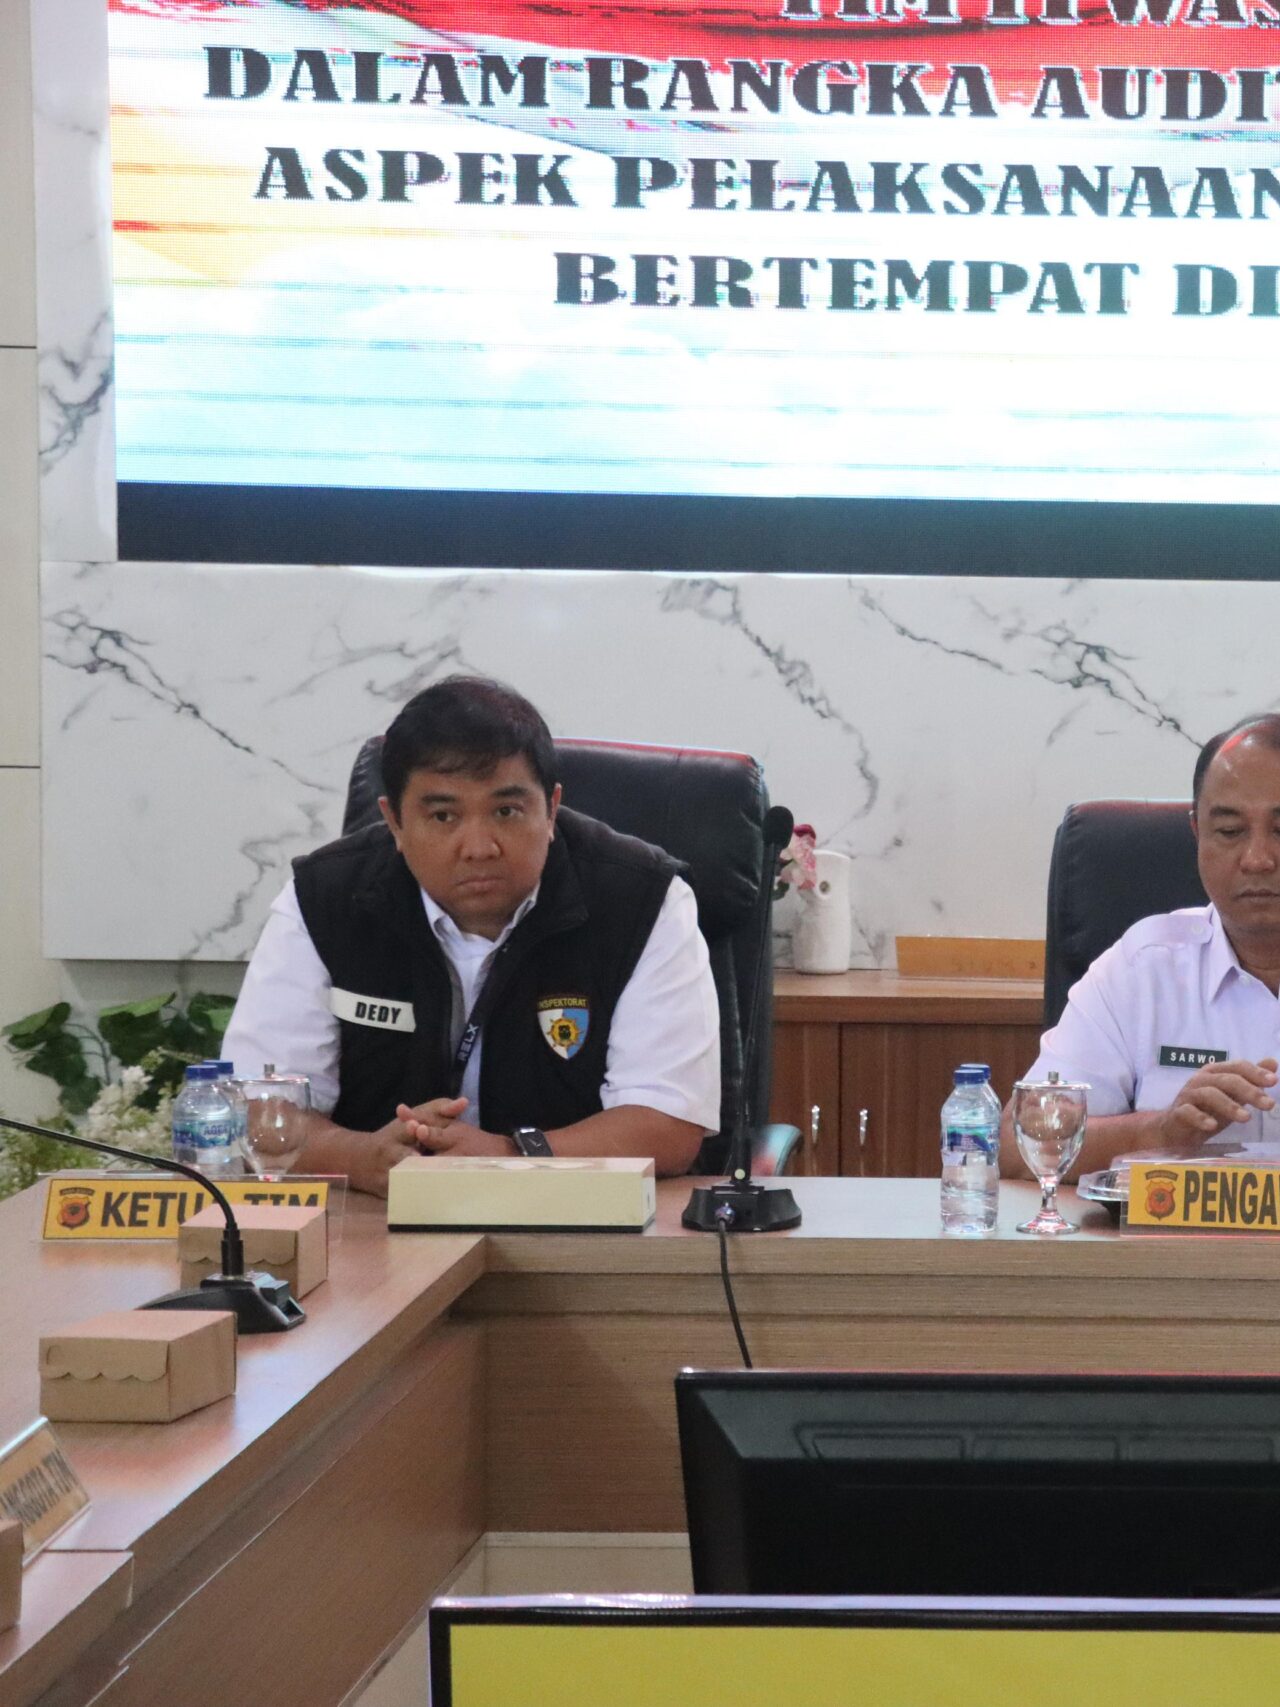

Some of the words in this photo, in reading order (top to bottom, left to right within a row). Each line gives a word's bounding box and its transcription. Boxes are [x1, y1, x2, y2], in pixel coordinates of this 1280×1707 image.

[203, 47, 549, 108] DALAM
[585, 58, 997, 117] RANGKA
[253, 147, 580, 207] ASPEK
[553, 252, 1141, 315] BERTEMPAT
[355, 1001, 401, 1024] DEDY
[457, 1022, 479, 1062] RELX
[1170, 1052, 1216, 1064] SARWO
[101, 1191, 220, 1228] KETU
